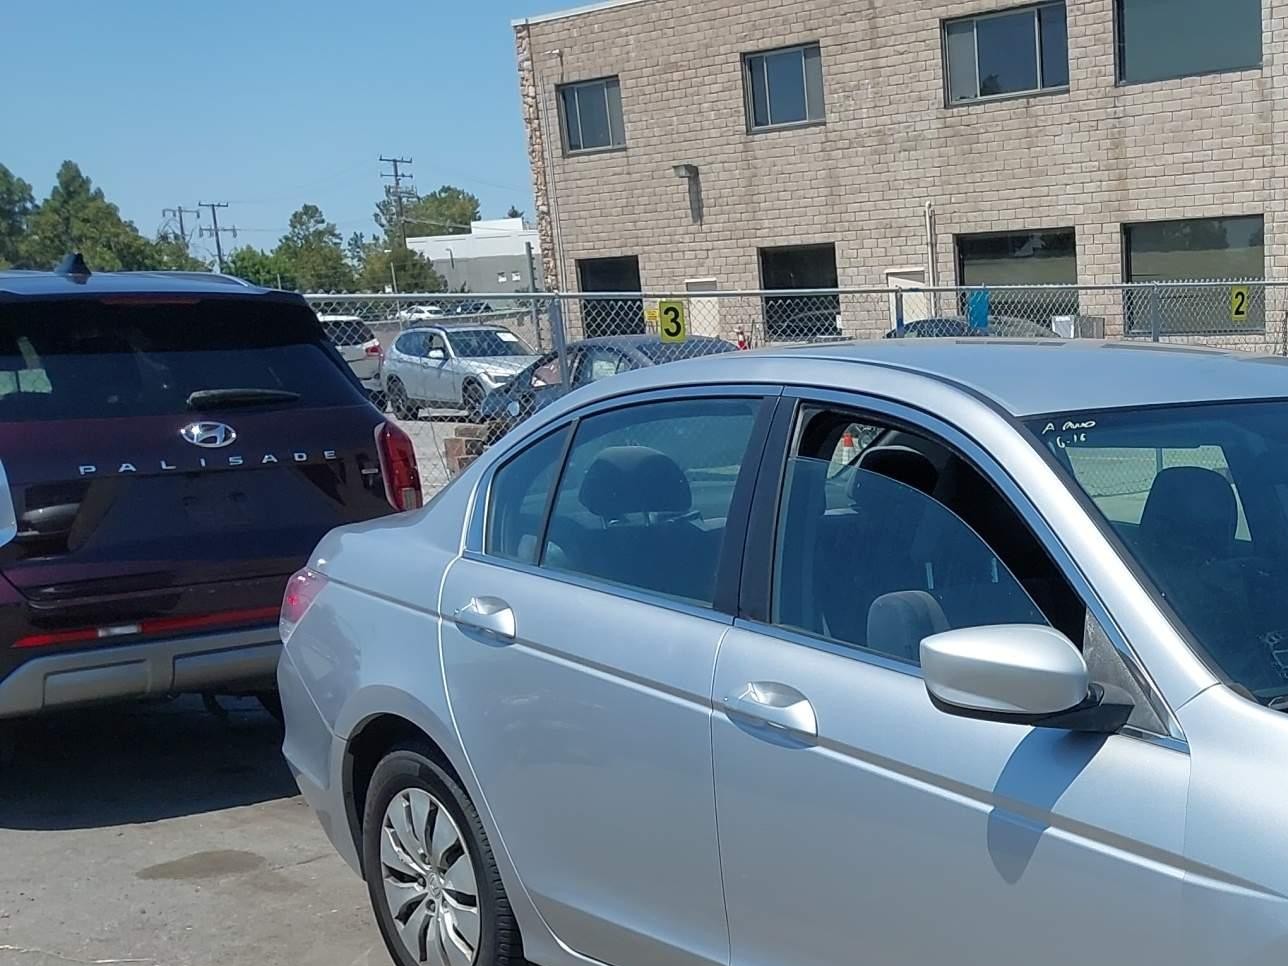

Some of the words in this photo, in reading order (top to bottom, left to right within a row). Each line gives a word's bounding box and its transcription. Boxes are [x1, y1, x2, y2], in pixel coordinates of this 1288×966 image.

[1235, 291, 1245, 316] 2
[663, 306, 682, 337] 3
[79, 450, 337, 476] PALISADE
